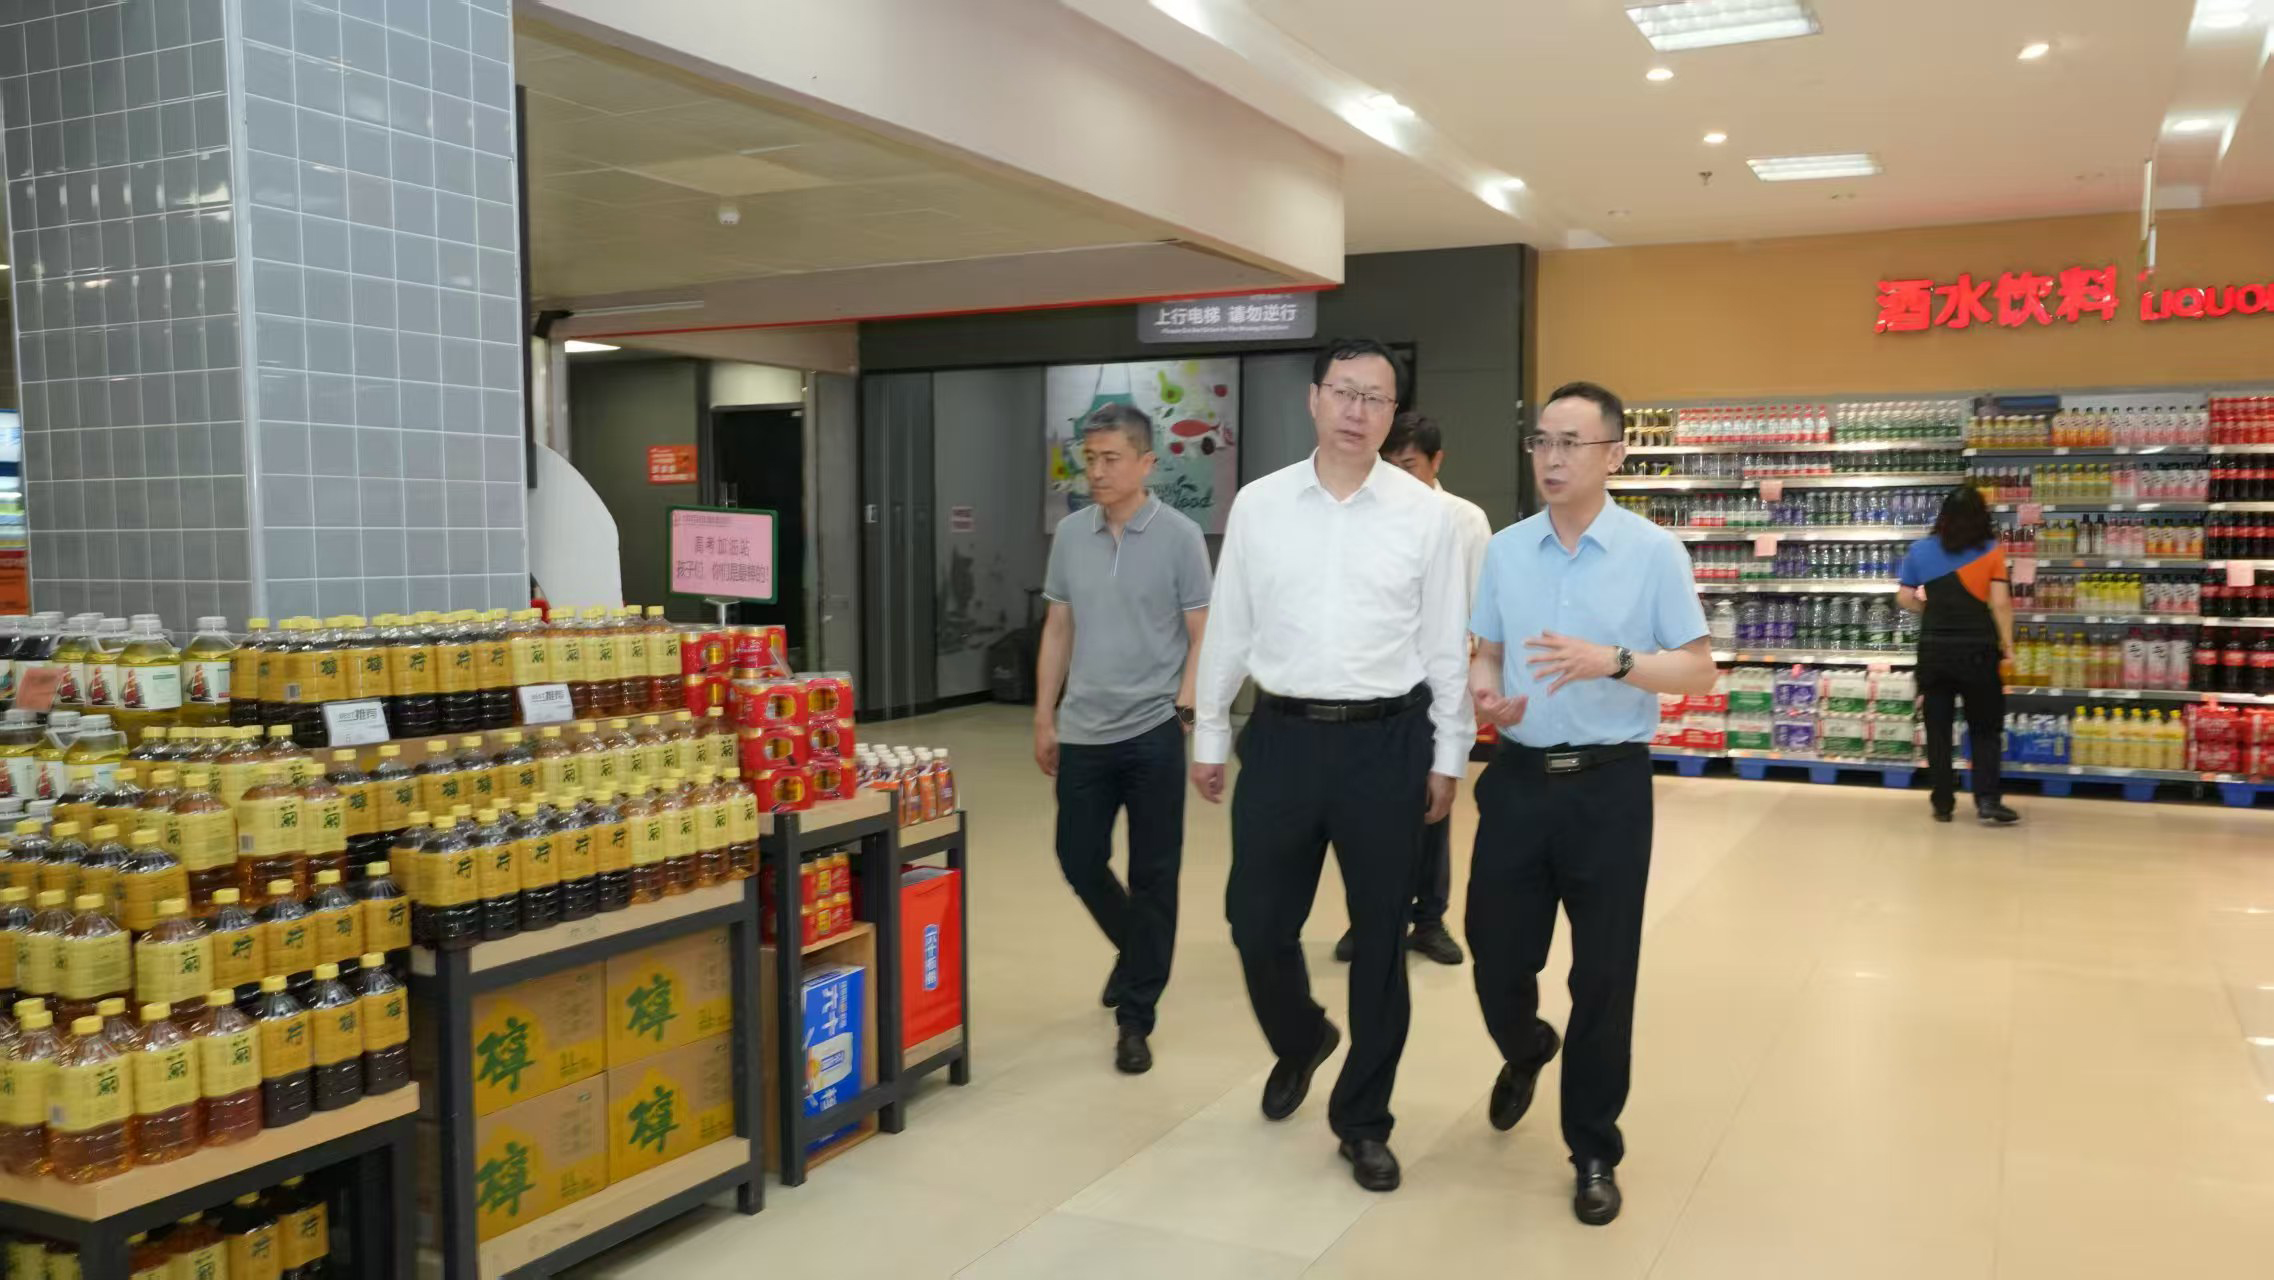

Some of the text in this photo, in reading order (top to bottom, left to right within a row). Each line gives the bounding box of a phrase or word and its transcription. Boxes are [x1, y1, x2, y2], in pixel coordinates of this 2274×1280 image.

[1153, 303, 1297, 327] 上行电梯 请勿逆行
[1874, 264, 2119, 334] 酒水饮料
